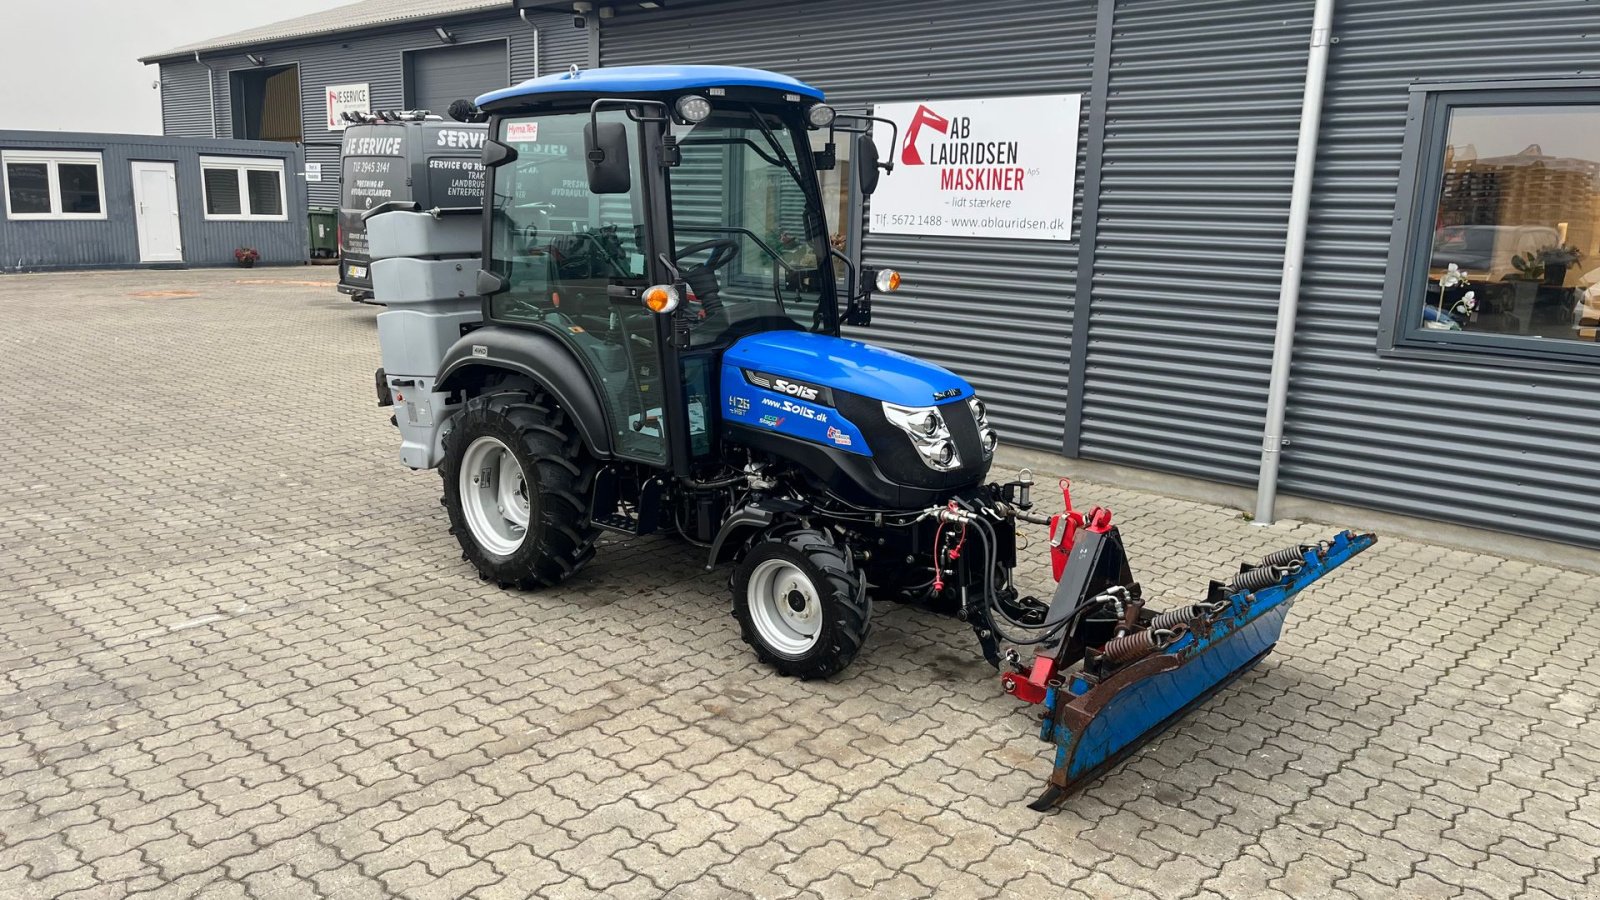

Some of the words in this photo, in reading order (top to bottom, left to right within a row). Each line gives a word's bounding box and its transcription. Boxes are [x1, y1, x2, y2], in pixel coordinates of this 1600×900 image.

[343, 90, 366, 102] SERVICE
[950, 116, 970, 139] AB
[437, 129, 489, 149] SERVI
[345, 138, 357, 154] JE
[357, 137, 401, 154] SERVICE
[930, 141, 1018, 165] LAURIDSEN
[361, 162, 375, 172] 2945
[376, 162, 390, 173] 3141
[429, 160, 460, 170] SERVICE
[462, 162, 473, 170] OG
[468, 171, 486, 180] TRAK
[941, 168, 1025, 191] MASKINER
[1026, 168, 1040, 176] ApS
[451, 179, 486, 188] LANDBRUG
[447, 187, 486, 197] ENTREPREN
[951, 197, 967, 207] lidt
[968, 197, 1012, 208] stærkere
[875, 213, 889, 227] Tlf.
[891, 215, 915, 225] 5672
[917, 215, 942, 226] 1488
[951, 216, 1064, 230] www.ablauridsen.dk
